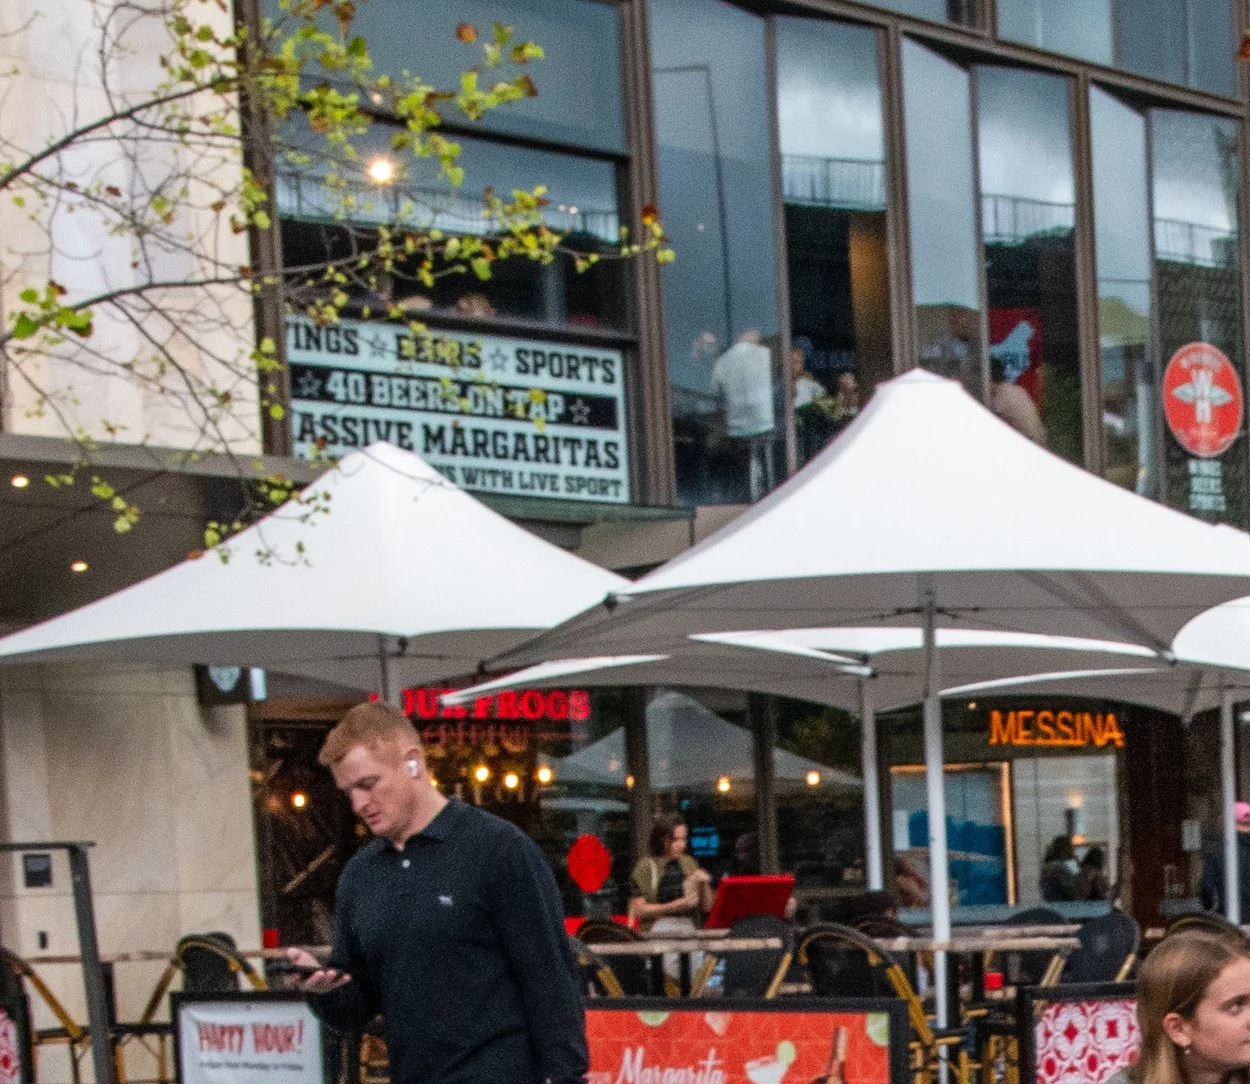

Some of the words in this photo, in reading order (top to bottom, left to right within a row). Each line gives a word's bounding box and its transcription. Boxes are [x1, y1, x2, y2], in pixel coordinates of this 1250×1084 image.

[287, 321, 360, 356] INGS
[515, 347, 616, 384] SPORTS
[326, 370, 368, 402] 40
[370, 374, 461, 414] BEERS
[467, 384, 504, 417] ON
[506, 388, 565, 422] TAP
[297, 411, 415, 451] ASSIVE
[421, 422, 620, 469] MARGARITAS
[461, 465, 513, 489] WITH
[518, 471, 560, 493] LIVE
[564, 475, 622, 498] SPORT
[402, 688, 468, 719] OUR
[474, 688, 591, 720] FROGS
[988, 709, 1126, 748] MESSINA
[196, 1023, 245, 1055] HAPPY
